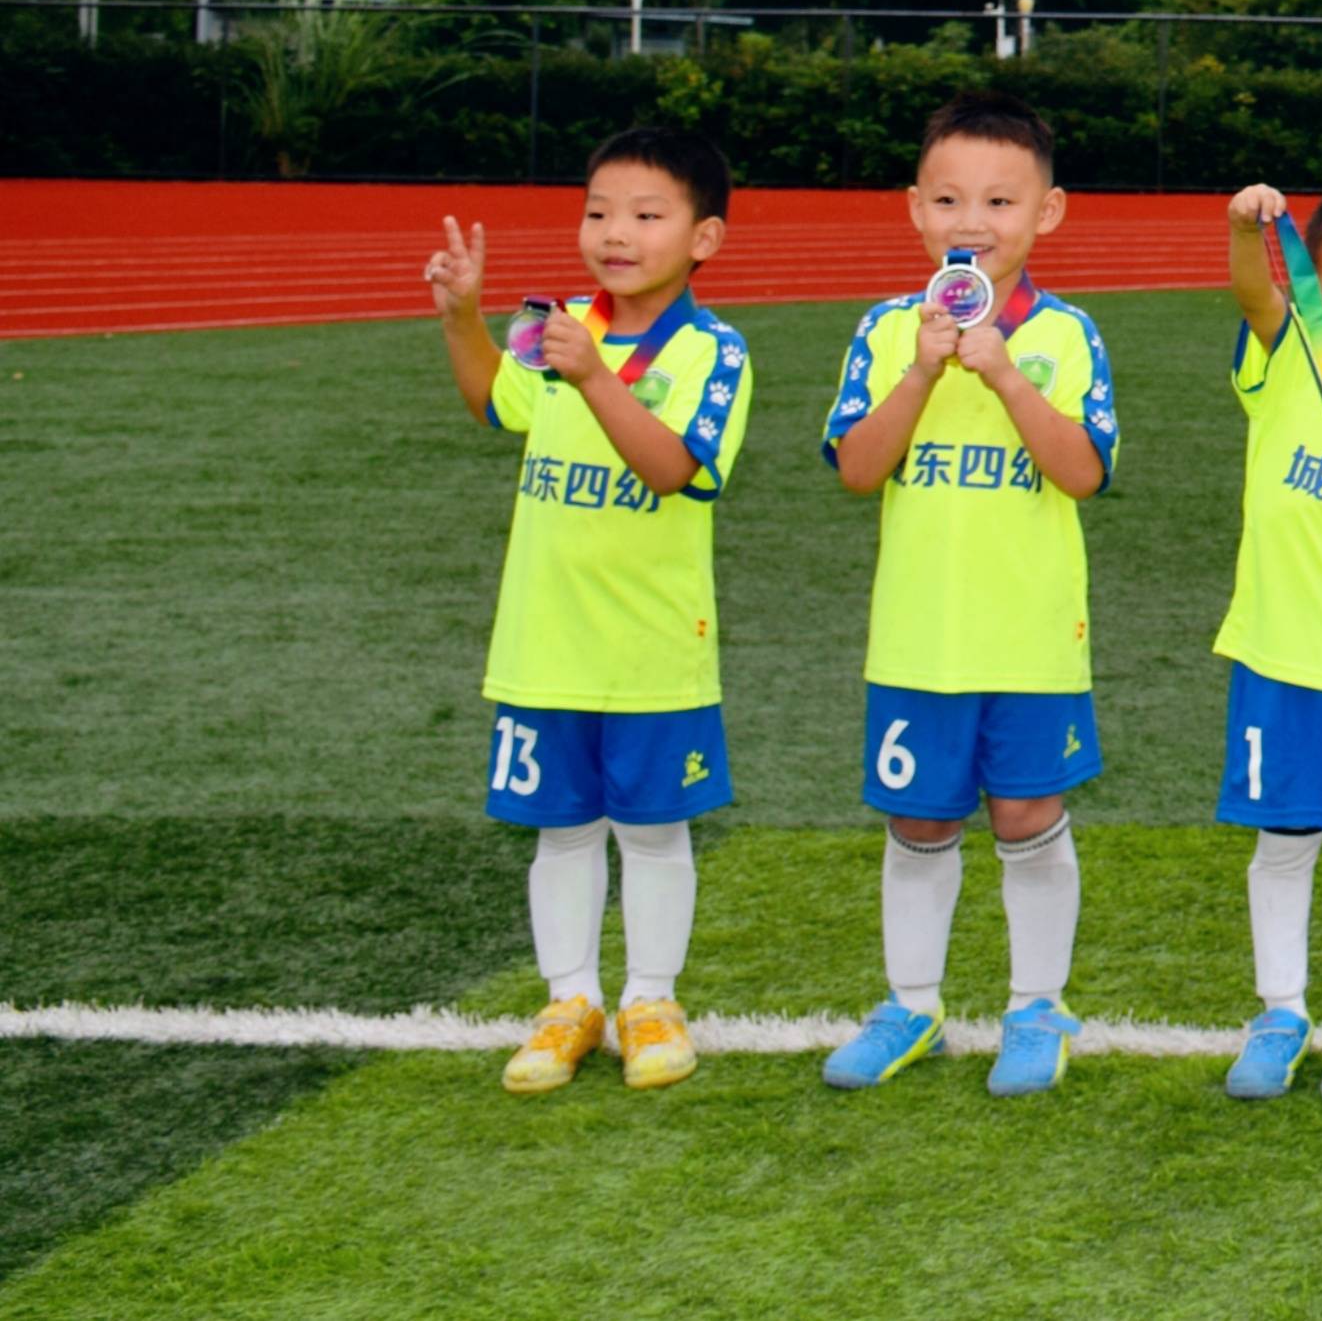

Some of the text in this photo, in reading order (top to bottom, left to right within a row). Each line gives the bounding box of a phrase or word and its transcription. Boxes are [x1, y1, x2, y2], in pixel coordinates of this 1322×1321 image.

[893, 441, 1043, 494] 东四幼
[492, 716, 541, 796] 13
[876, 719, 916, 790] 6
[1243, 726, 1263, 801] 1
